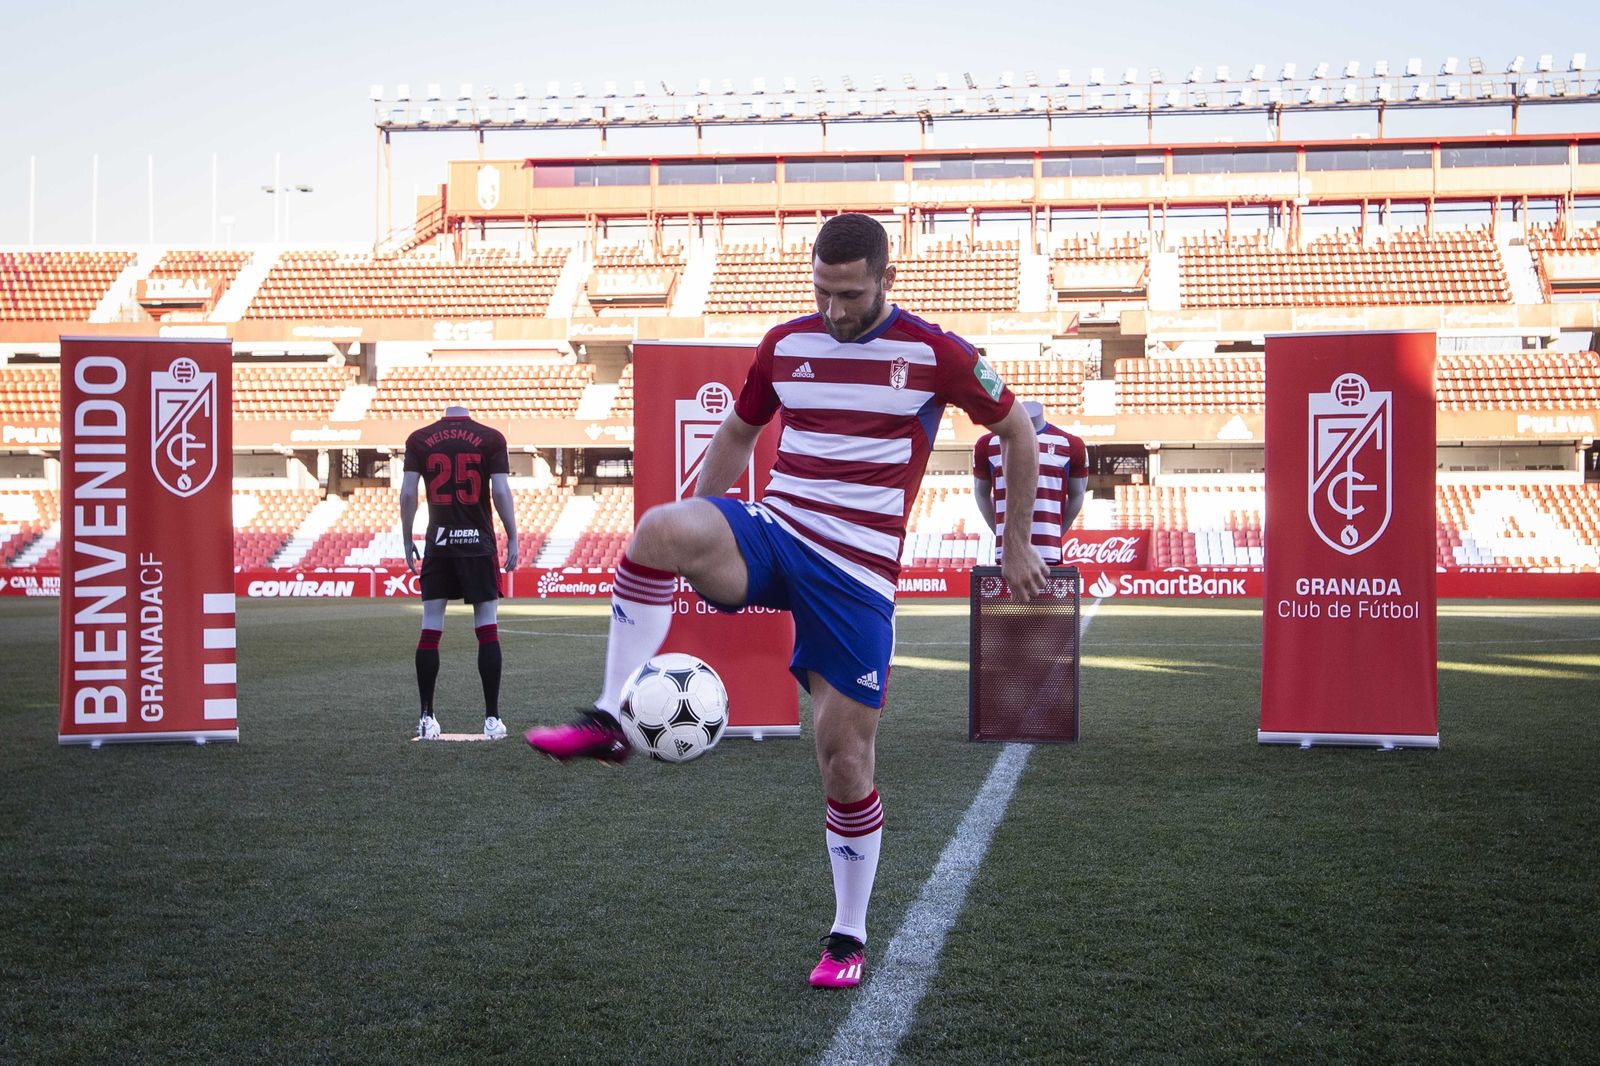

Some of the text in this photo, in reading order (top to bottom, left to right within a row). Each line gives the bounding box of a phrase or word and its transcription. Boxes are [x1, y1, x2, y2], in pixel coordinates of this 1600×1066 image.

[791, 371, 816, 379] adidas
[424, 428, 483, 447] WEISSMAN
[426, 452, 481, 505] 25
[74, 355, 127, 725] BIENVENIDO
[448, 528, 480, 538] LIDERA
[1062, 536, 1141, 564] Coca-Cola
[547, 581, 597, 595] Greening
[897, 578, 948, 592] HAMBRA
[1119, 574, 1247, 595] SmartBank
[1295, 577, 1402, 596] GRANADA
[1277, 599, 1420, 619] Club de Fútbol
[856, 677, 881, 691] adidas
